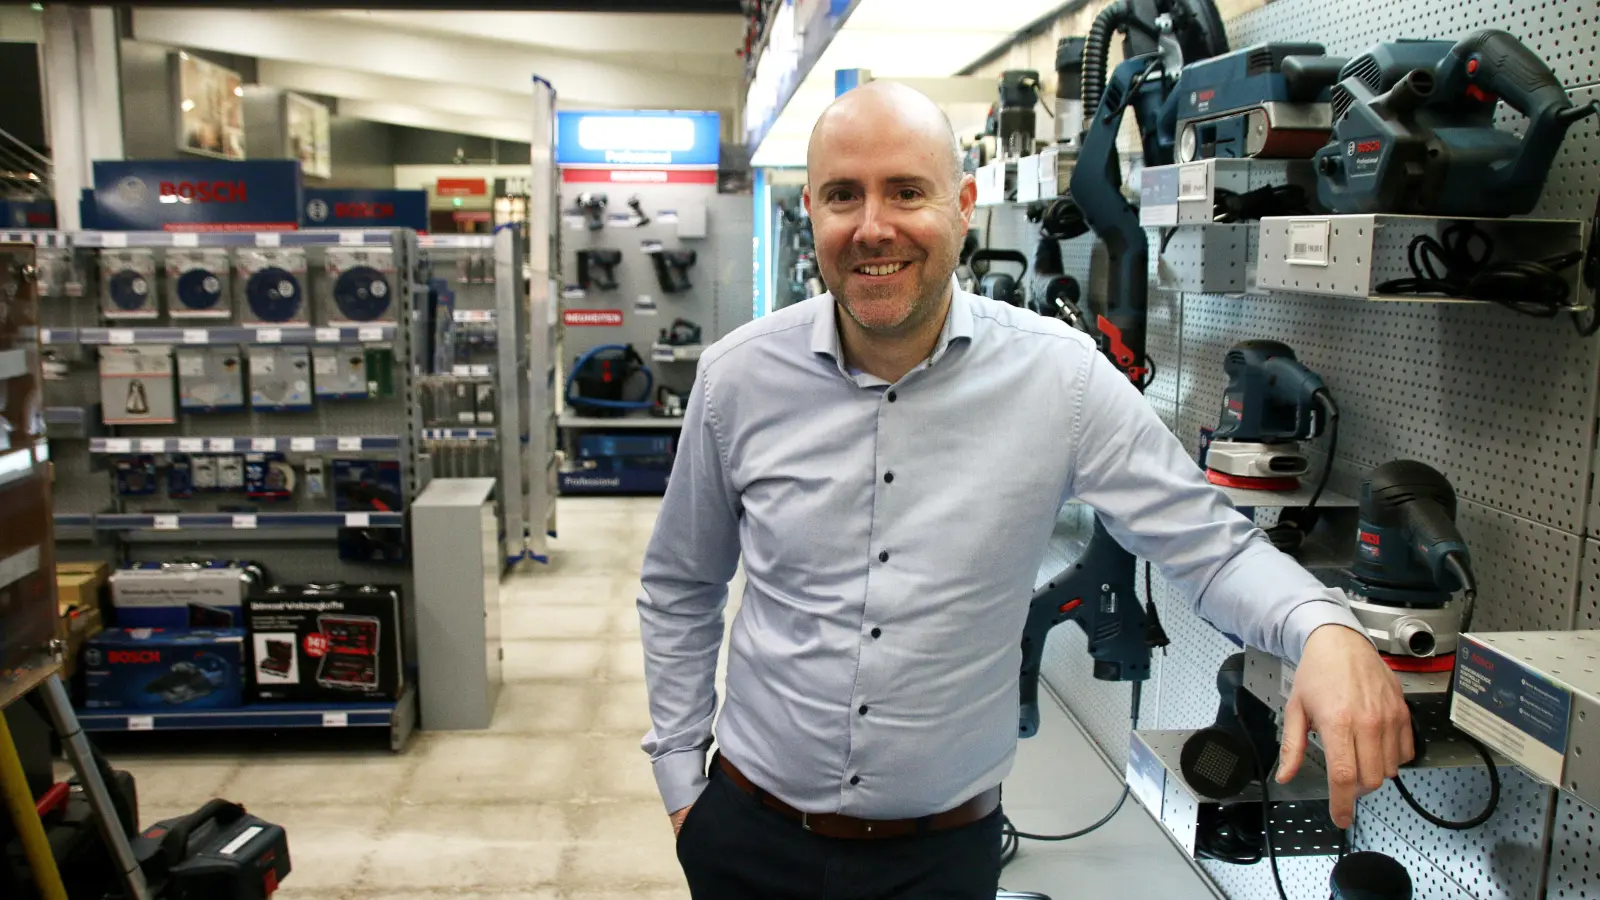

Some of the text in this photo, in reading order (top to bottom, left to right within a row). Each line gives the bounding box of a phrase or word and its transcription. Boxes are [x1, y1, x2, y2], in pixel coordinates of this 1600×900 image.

[1357, 140, 1380, 152] BOSCH
[159, 181, 247, 204] BOSCH
[335, 202, 394, 219] BOSCH
[564, 476, 619, 487] Professional
[107, 650, 161, 664] BOSCH
